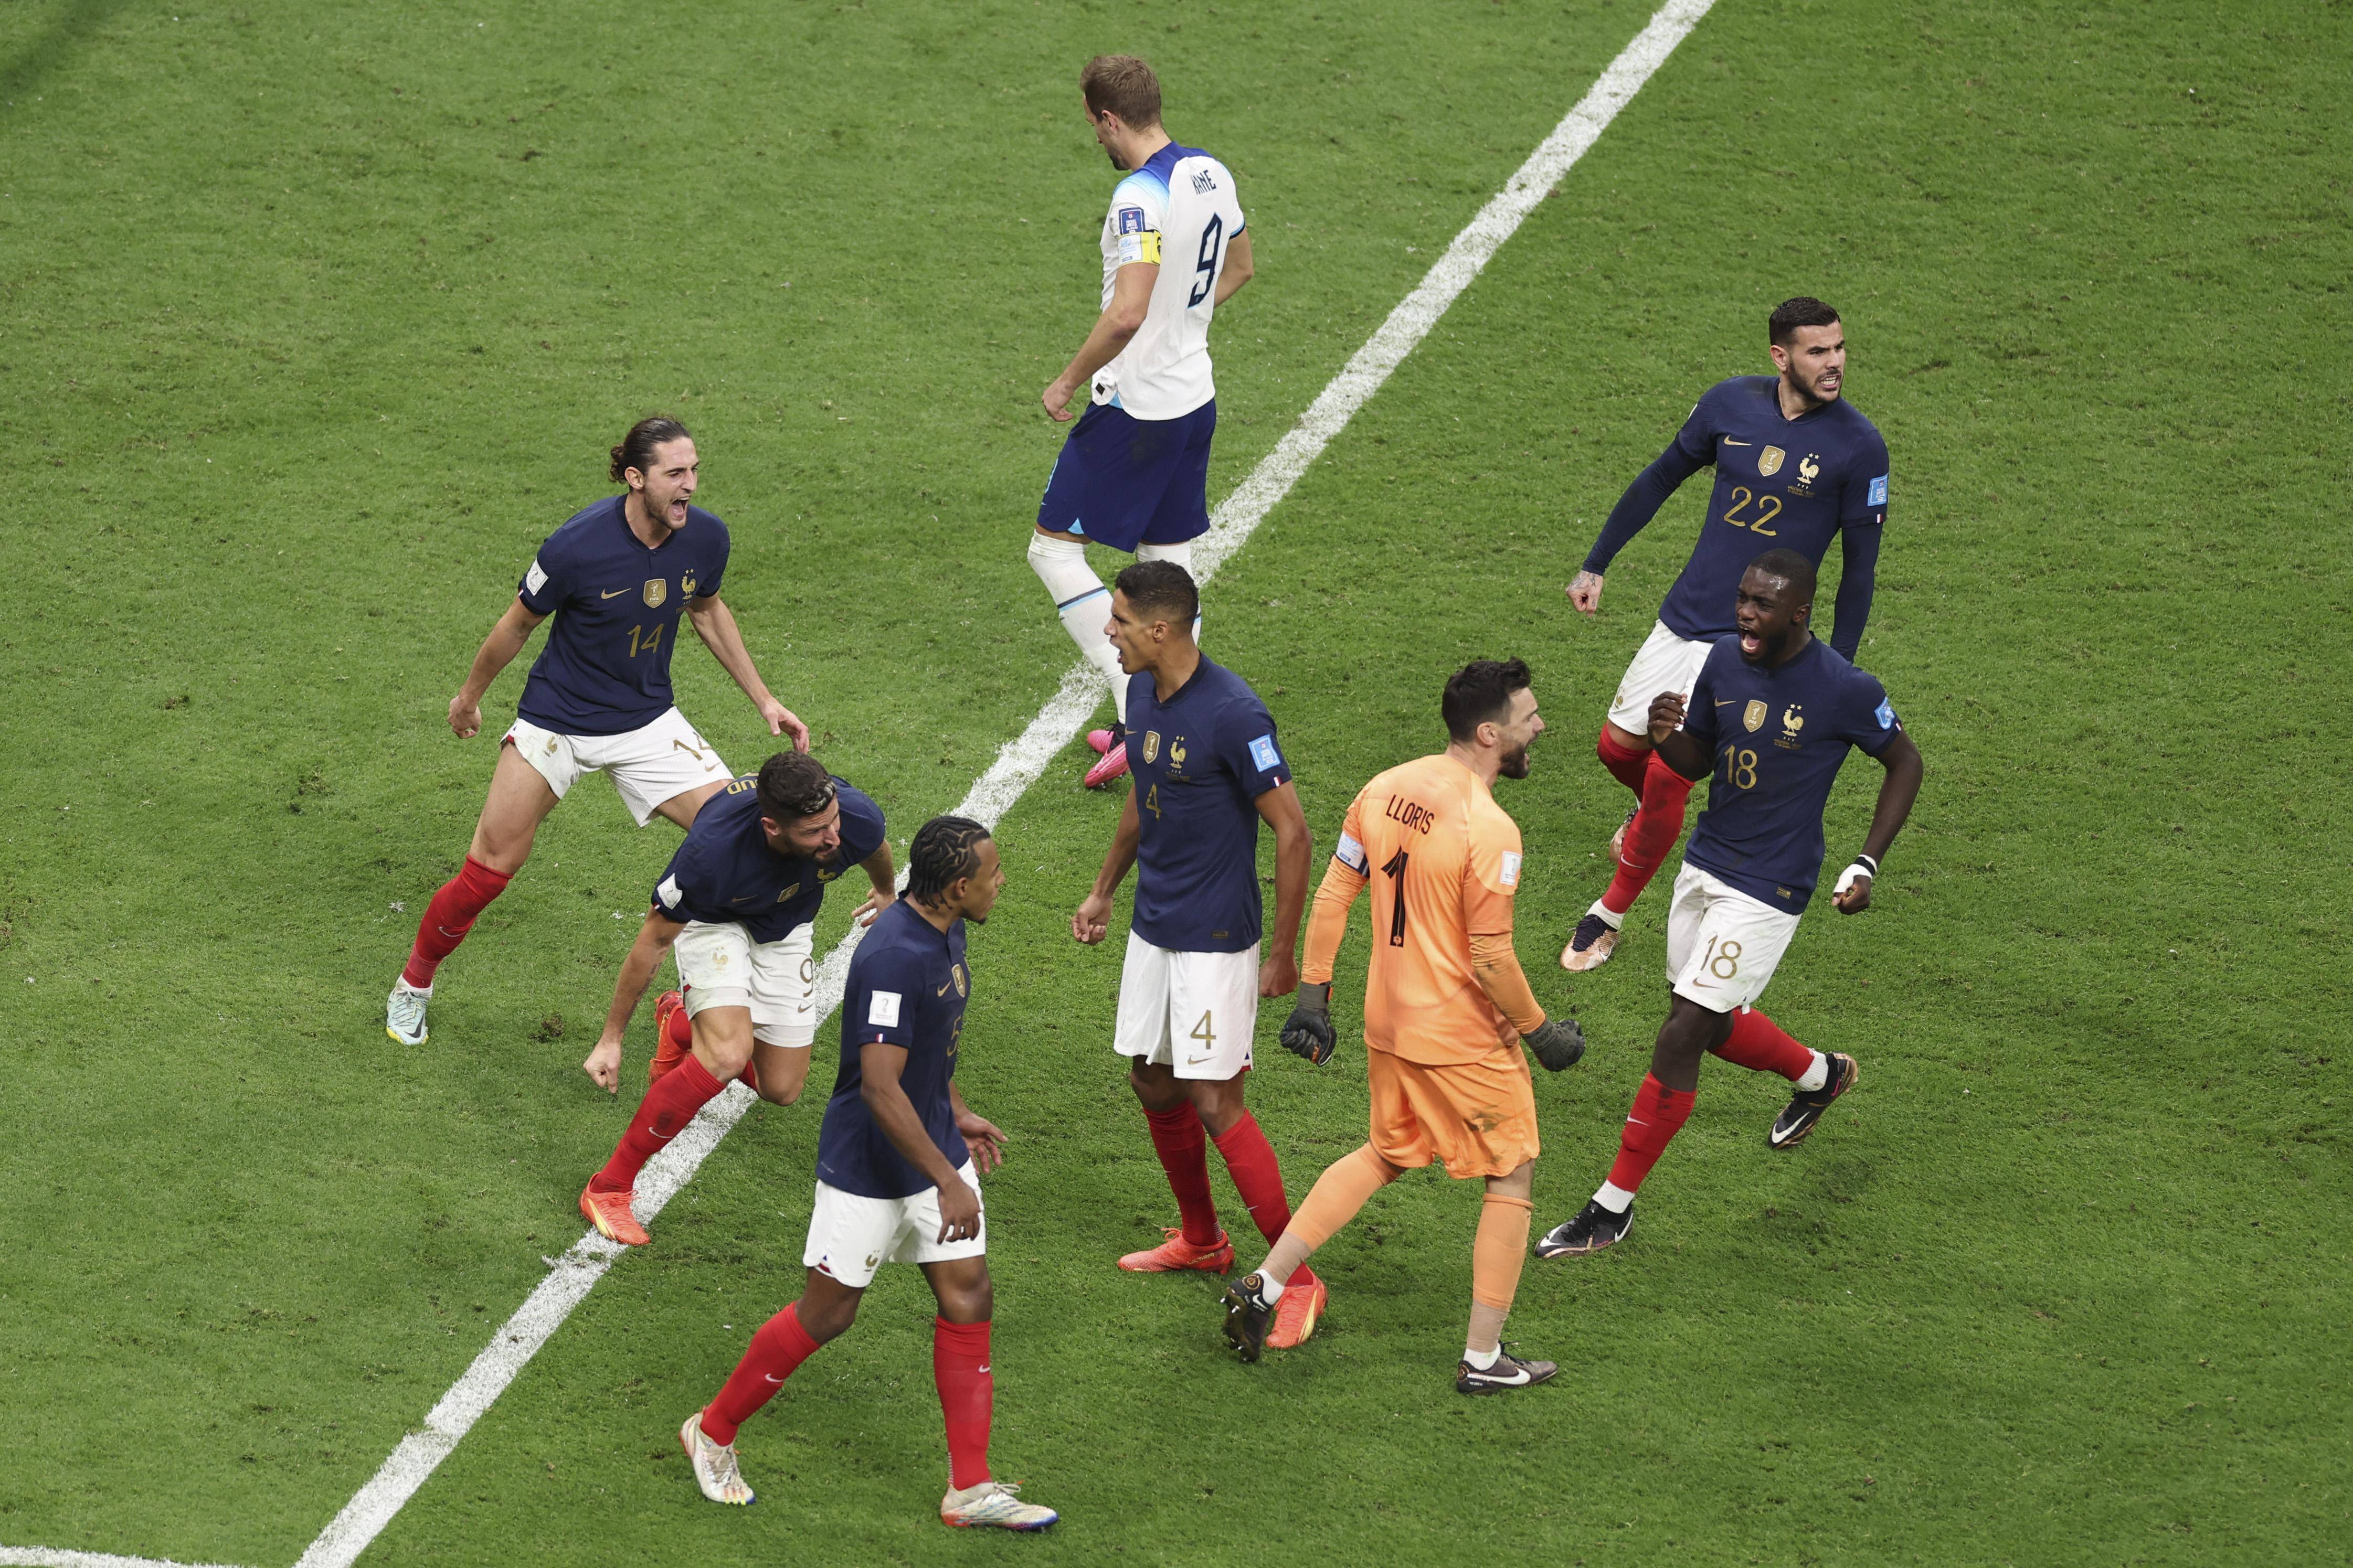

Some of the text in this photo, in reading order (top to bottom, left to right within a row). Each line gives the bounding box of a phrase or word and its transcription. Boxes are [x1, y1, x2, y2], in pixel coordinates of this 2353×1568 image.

[1190, 169, 1216, 195] KANE
[1187, 212, 1222, 308] 9
[1723, 486, 1782, 536] 22
[627, 623, 664, 657] 14
[1724, 745, 1757, 789] 18
[1146, 782, 1161, 822] 4
[1386, 794, 1434, 835] LLORIS
[1381, 845, 1408, 947] 1
[800, 958, 813, 997] 9
[1700, 935, 1742, 979] 18
[1190, 1009, 1216, 1050] 4
